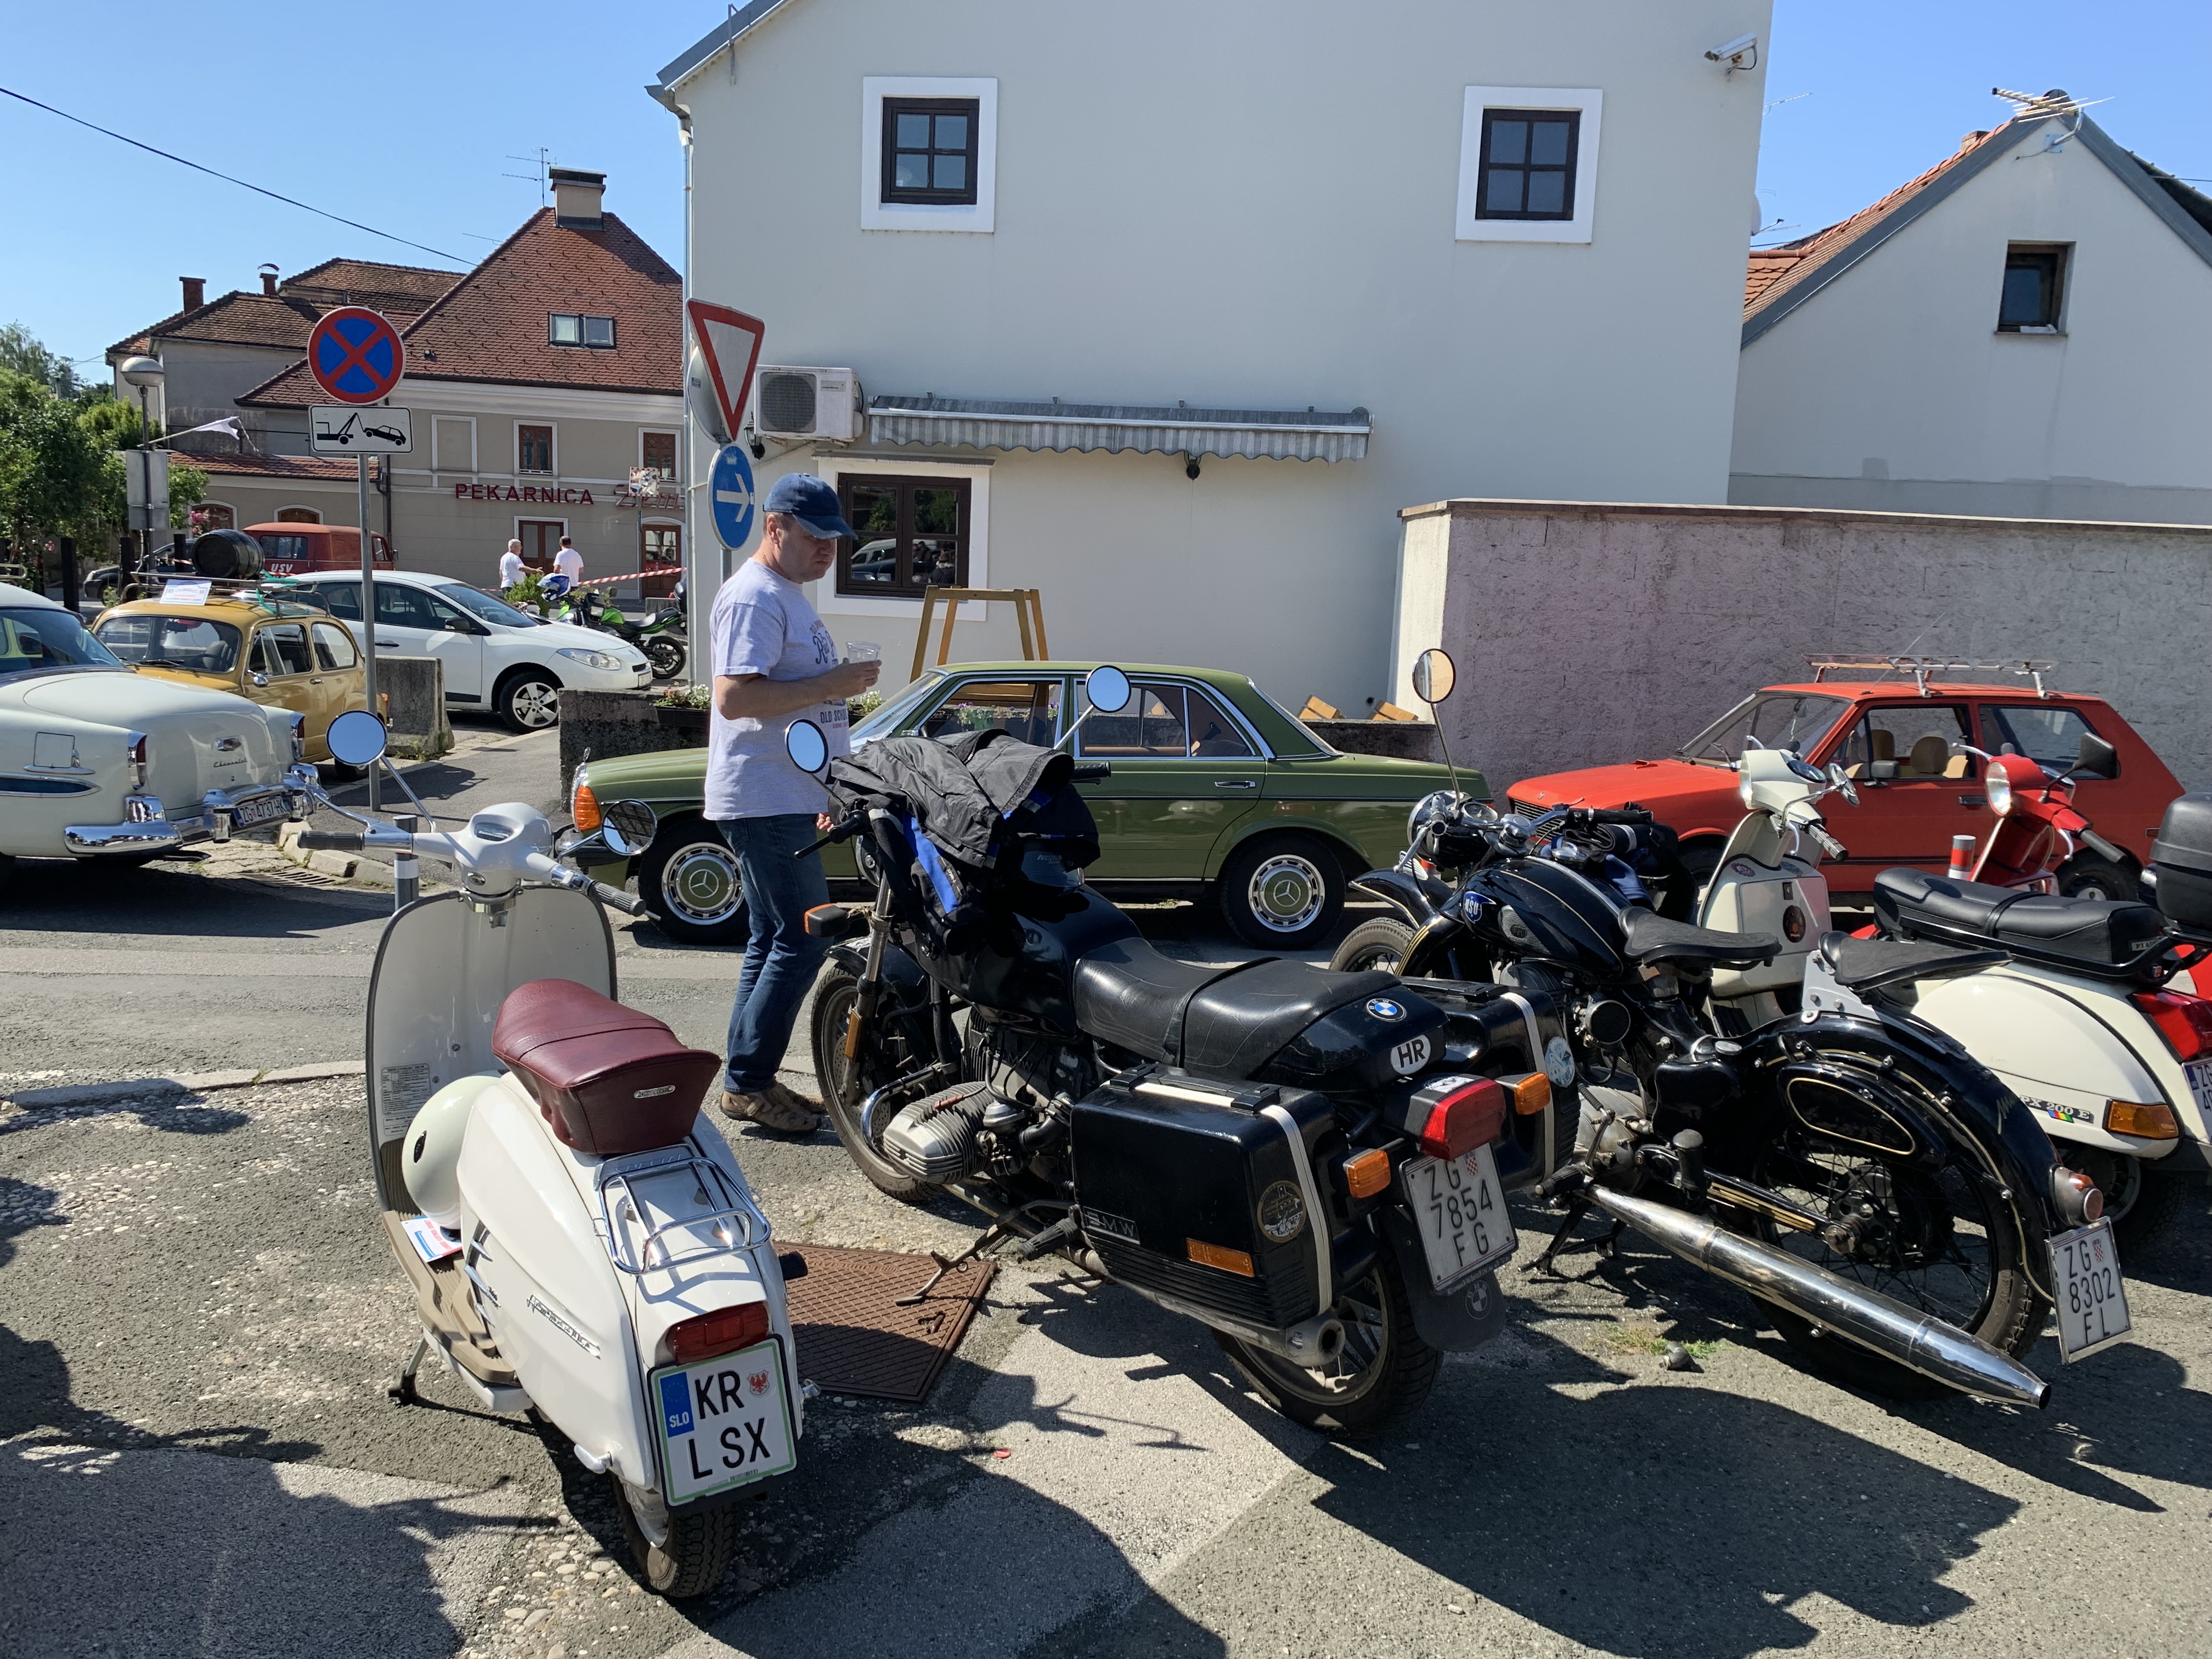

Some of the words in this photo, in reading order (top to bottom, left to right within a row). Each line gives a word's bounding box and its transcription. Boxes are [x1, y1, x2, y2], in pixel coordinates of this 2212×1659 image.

[455, 483, 594, 505] PEKARNICA
[271, 563, 293, 573] USV
[820, 712, 832, 724] OLD
[240, 806, 253, 822] ZG
[1465, 898, 1479, 916] NSU
[1369, 998, 1390, 1010] BMW
[1397, 1039, 1426, 1068] HR
[2019, 1096, 2042, 1108] PX
[2046, 1102, 2074, 1116] 200
[2078, 1109, 2091, 1120] E
[1424, 1158, 1461, 1200] ZG
[1430, 1180, 1492, 1239] 7854
[1453, 1222, 1489, 1267] FG
[2064, 1240, 2091, 1279] ZG
[1468, 1283, 1487, 1299] BMW
[2069, 1268, 2115, 1313] 8302
[2084, 1307, 2111, 1344] FL
[695, 1370, 744, 1420] KR
[669, 1411, 690, 1428] SLO
